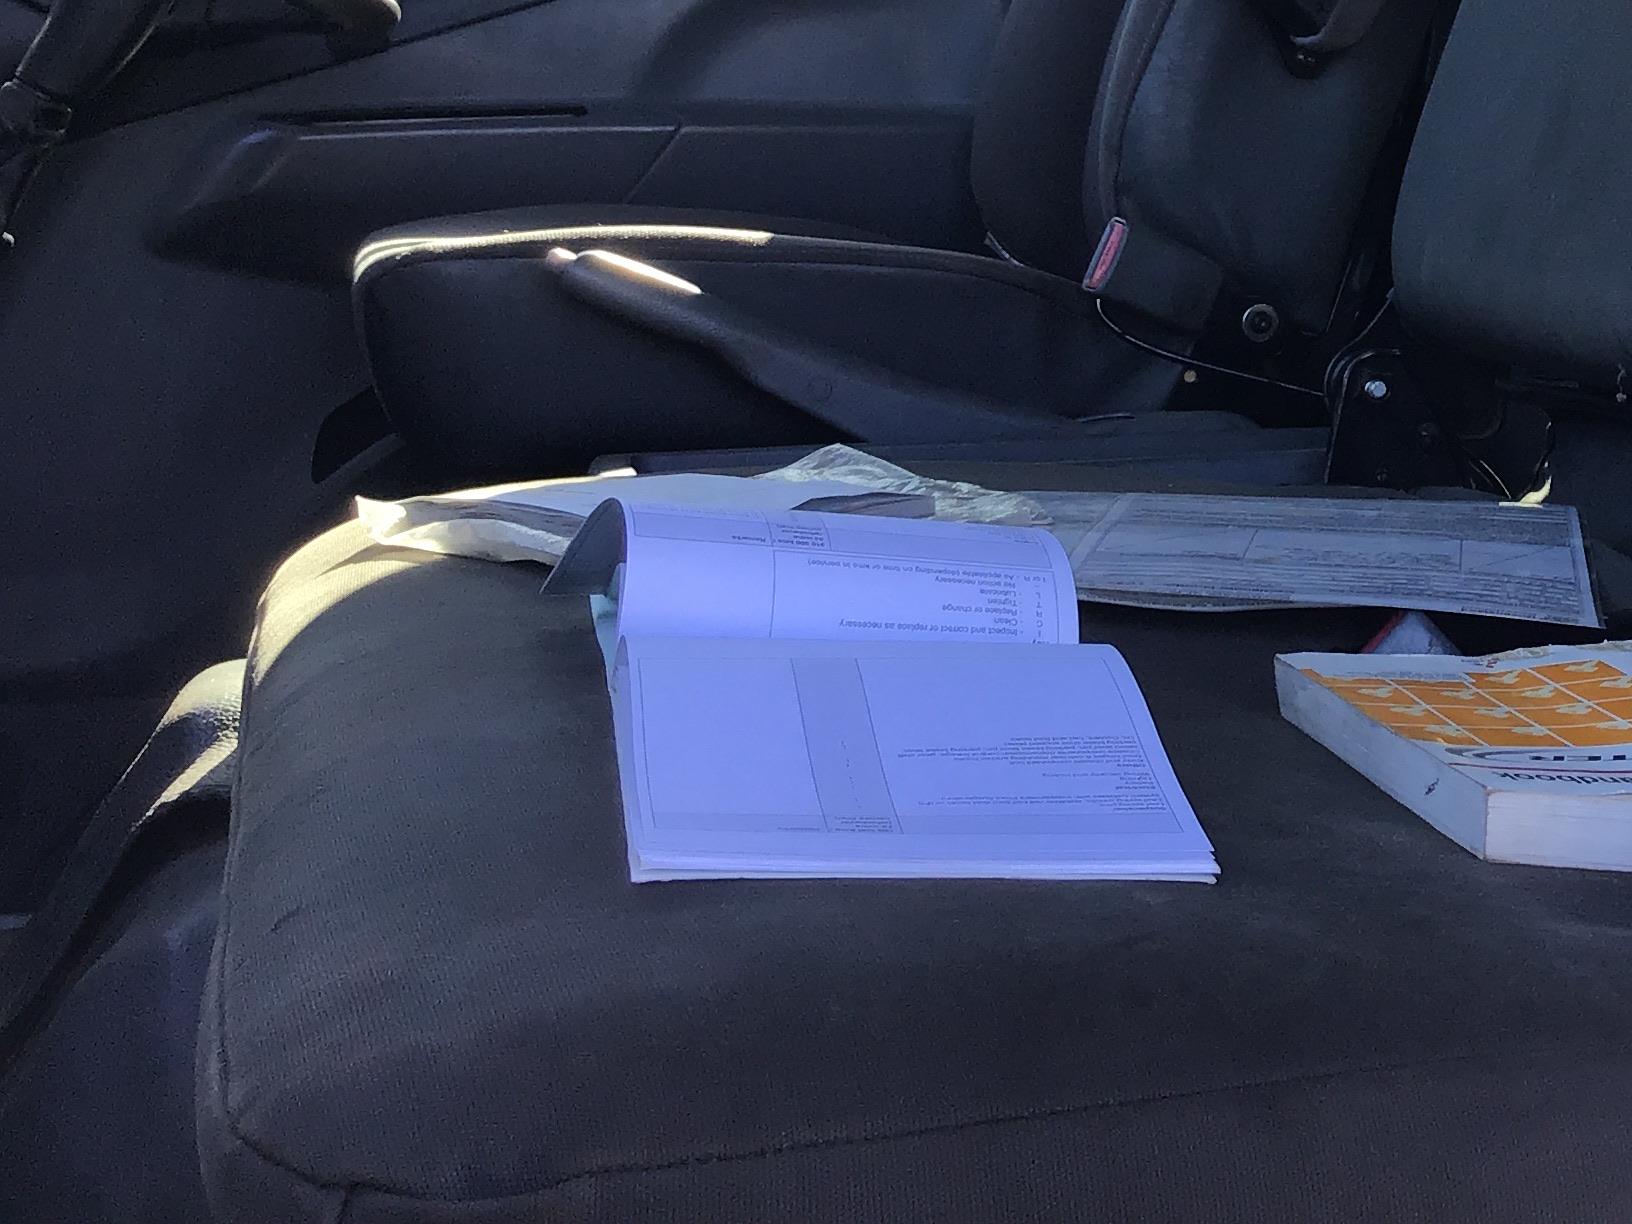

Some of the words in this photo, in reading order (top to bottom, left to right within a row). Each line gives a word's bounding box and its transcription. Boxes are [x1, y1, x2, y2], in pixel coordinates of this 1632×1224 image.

[807, 559, 841, 568] service)
[915, 566, 960, 577] (depending
[962, 571, 1002, 579] applicable
[934, 576, 976, 585] necessary
[1003, 573, 1014, 581] As
[978, 579, 1002, 587] action
[979, 588, 1017, 597] Lubricate
[987, 598, 1017, 607] Tighten
[942, 604, 973, 614] change
[985, 606, 1018, 616] Replace
[839, 619, 883, 629] necessary
[884, 622, 895, 630] as
[993, 617, 1018, 626] Clean
[897, 623, 928, 632] replace
[930, 624, 939, 632] or
[941, 625, 969, 634] correct
[971, 627, 986, 635] and
[988, 627, 1018, 637] Inspect
